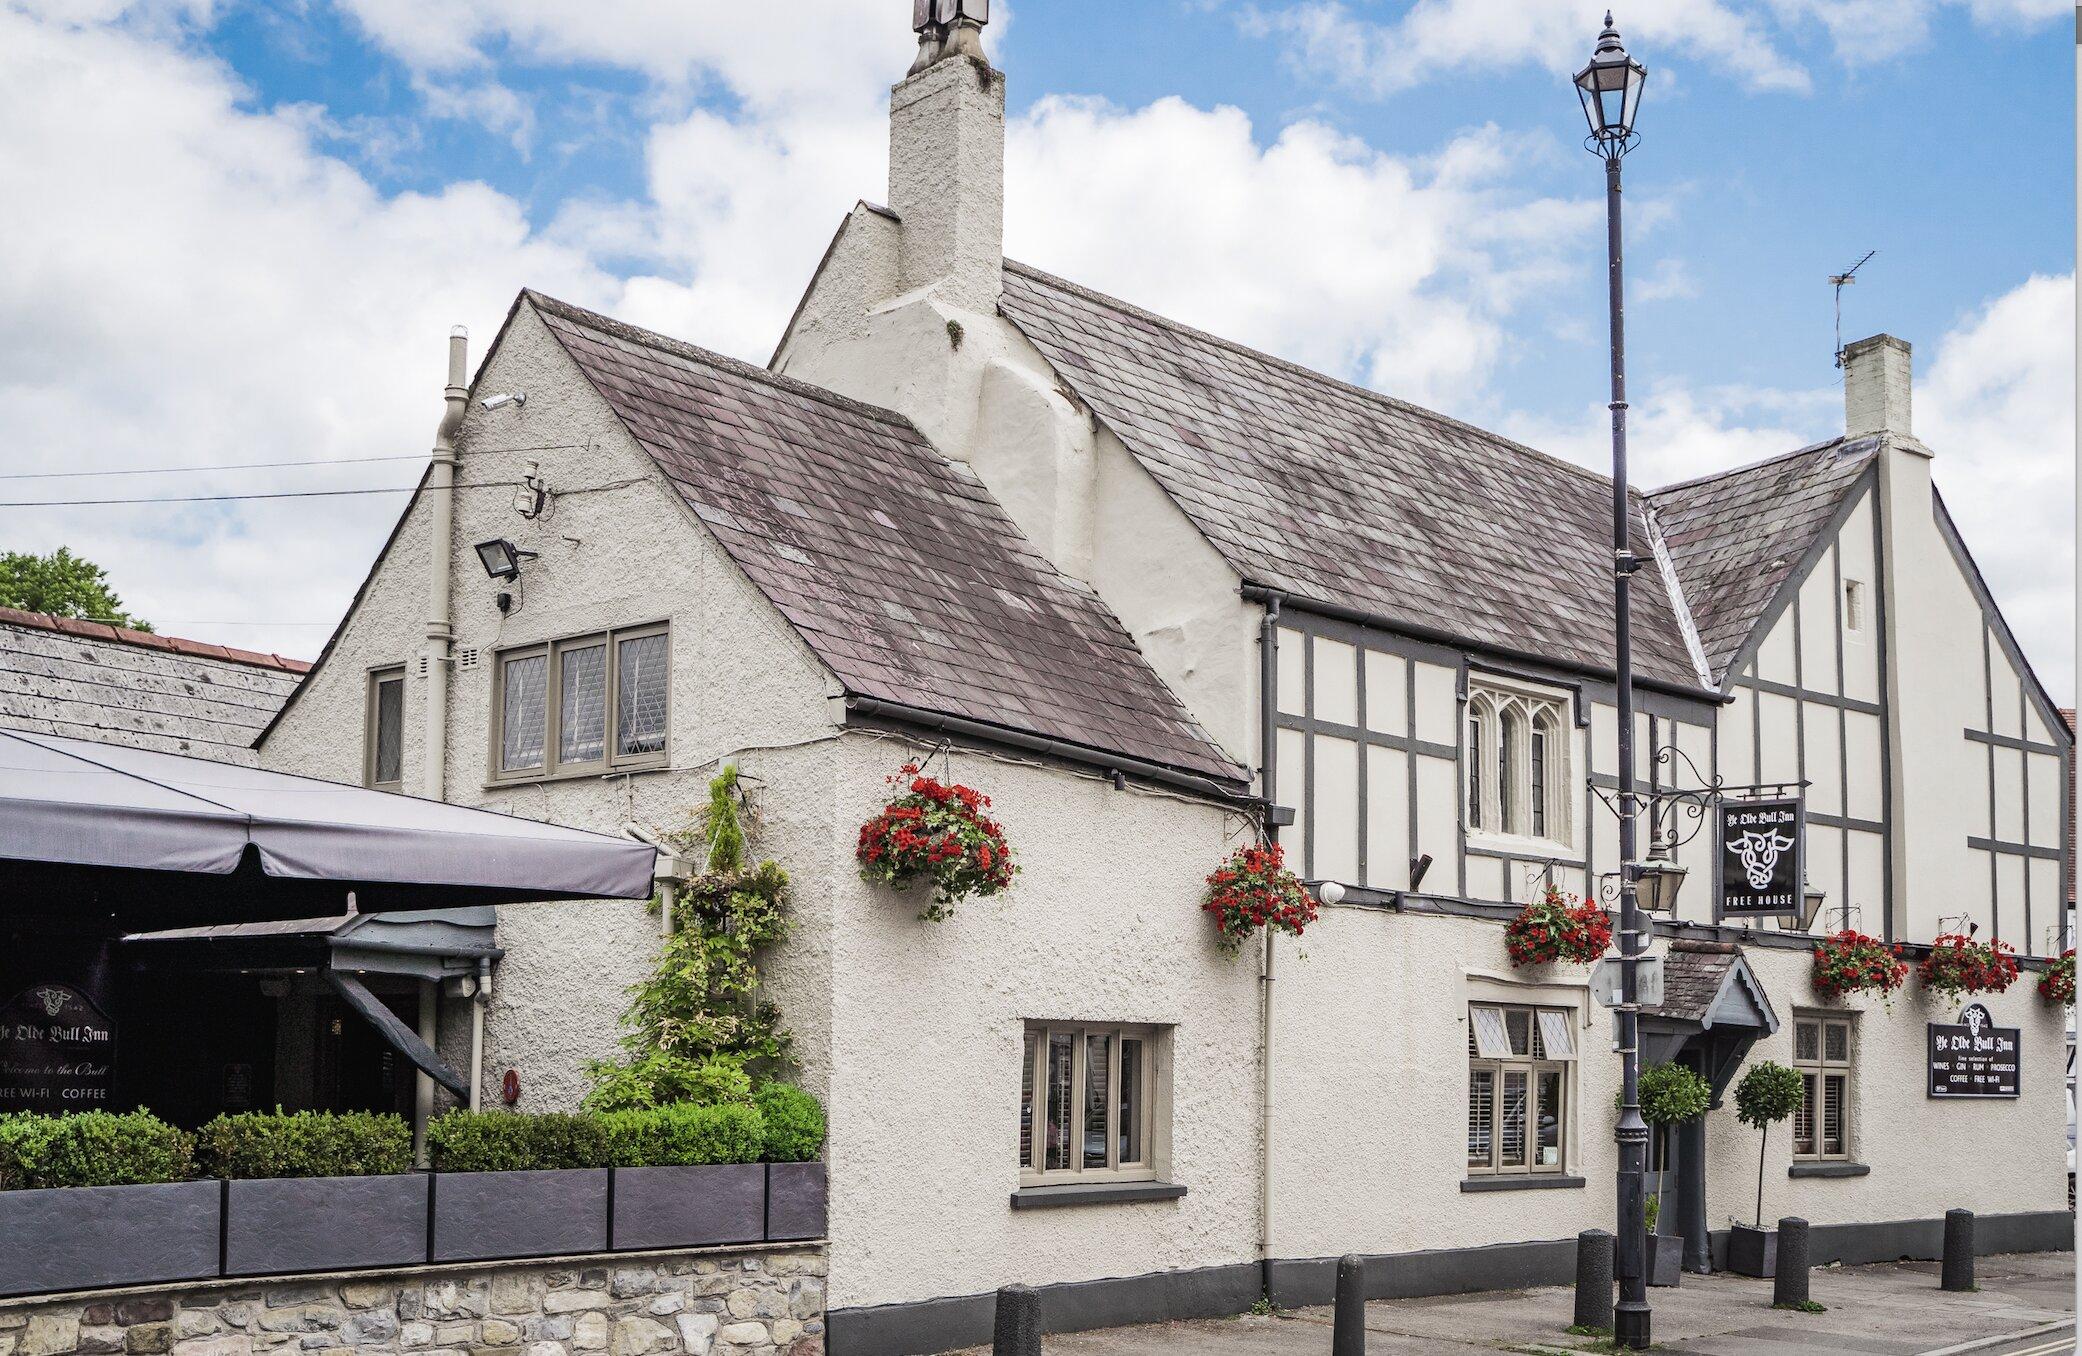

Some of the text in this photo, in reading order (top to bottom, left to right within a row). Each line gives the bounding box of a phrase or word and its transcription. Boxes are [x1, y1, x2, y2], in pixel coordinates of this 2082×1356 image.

[1727, 810, 1794, 827] Ye Olde Bull Inn
[1726, 894, 1792, 906] FREE HOUSE
[14, 1024, 45, 1041] Olde
[49, 1025, 79, 1043] Bull
[82, 1025, 109, 1043] Inn
[1936, 1035, 2013, 1053] Ye Olde Bull Inn
[57, 1064, 73, 1075] the
[75, 1062, 109, 1076] Bull
[1933, 1062, 2015, 1072] WINES GIN RUM PROSECCO
[1949, 1074, 1968, 1083] COFFEE
[1974, 1075, 1985, 1083] FREE
[20, 1087, 50, 1098] WI-FI
[62, 1088, 107, 1099] COFFEE
